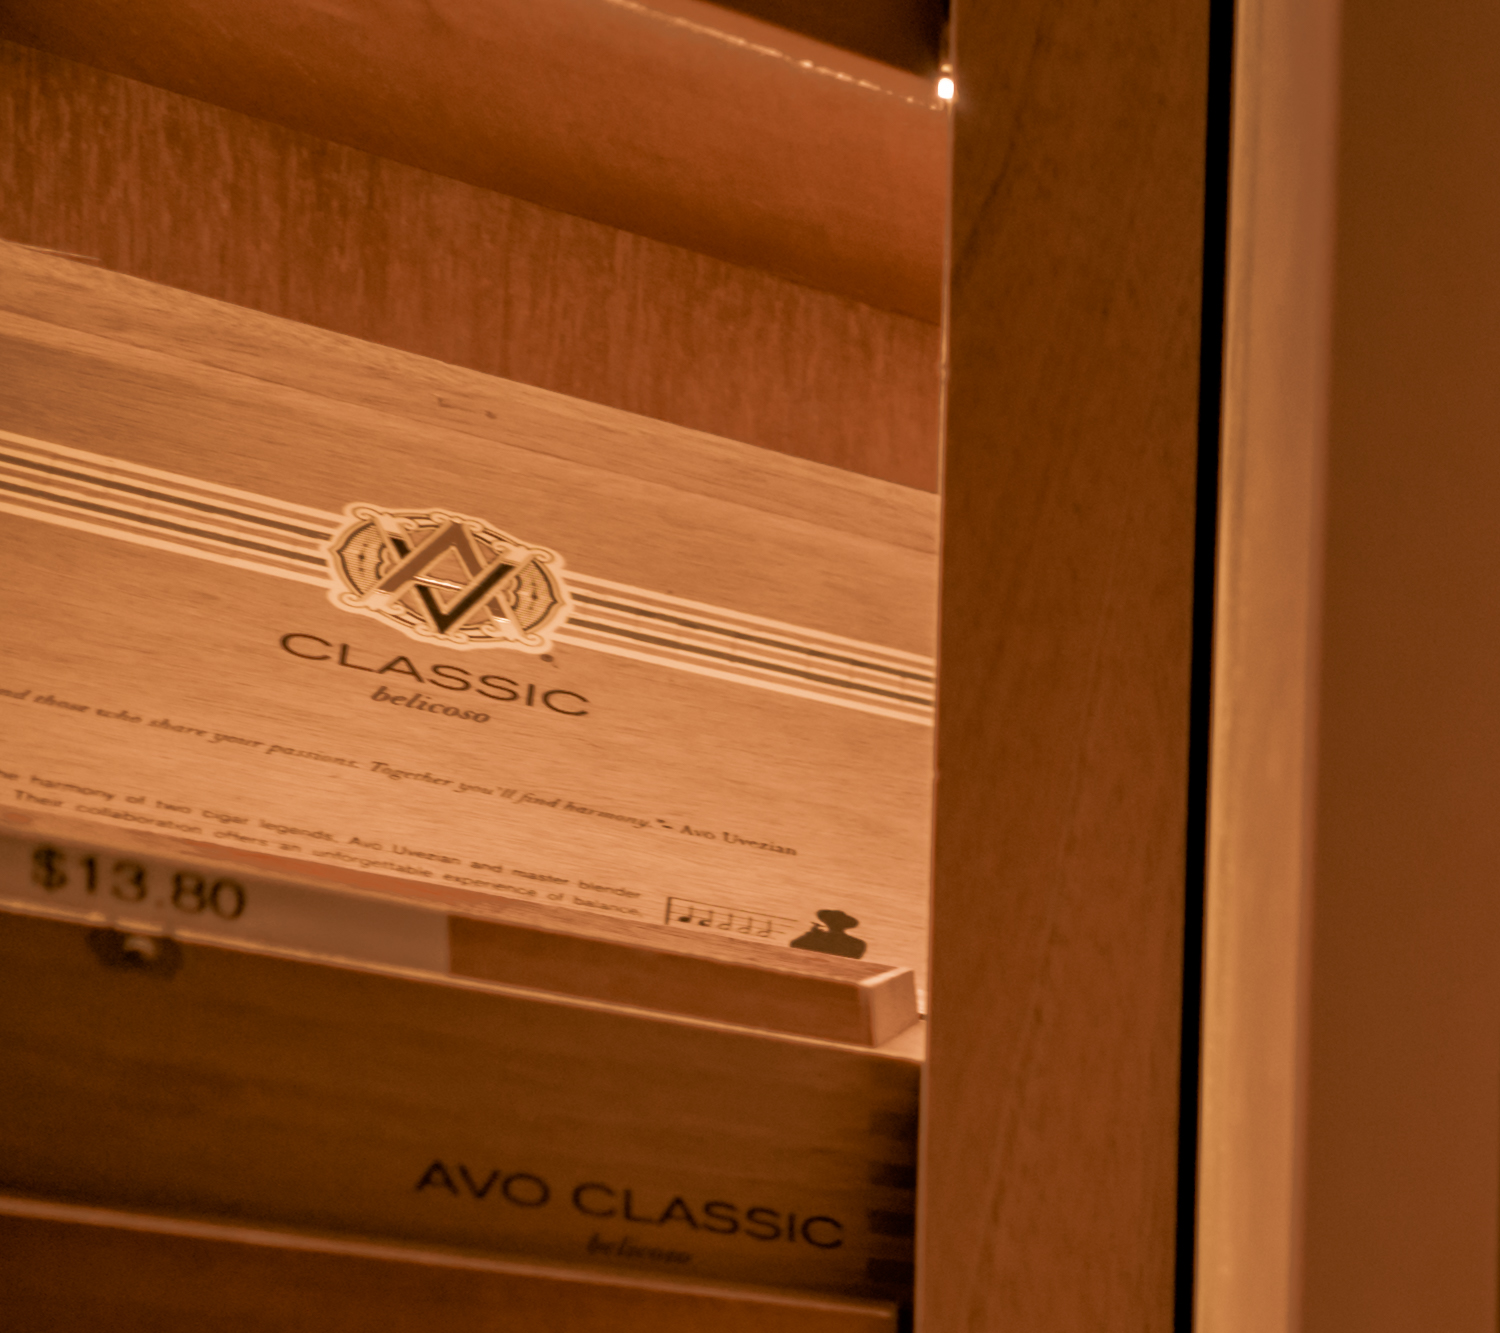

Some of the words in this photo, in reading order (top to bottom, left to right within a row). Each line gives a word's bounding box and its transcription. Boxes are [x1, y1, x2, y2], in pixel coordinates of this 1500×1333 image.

[280, 633, 589, 716] CLASSIC
[371, 686, 491, 723] belicoso
[148, 718, 205, 736] share
[207, 732, 264, 749] your
[371, 761, 453, 787] Together
[722, 831, 797, 857] Uvezian
[30, 774, 114, 802] harmony
[125, 794, 146, 806] of
[155, 799, 192, 815] two
[202, 808, 249, 828] cigar
[470, 858, 502, 874] and
[512, 866, 569, 886] master
[577, 879, 641, 900] blender
[30, 842, 247, 922] $13.80
[74, 801, 201, 835] collaboration
[441, 872, 537, 899] experience
[546, 892, 565, 903] of
[413, 1160, 551, 1209] AVO
[571, 1181, 845, 1251] CLASSIC
